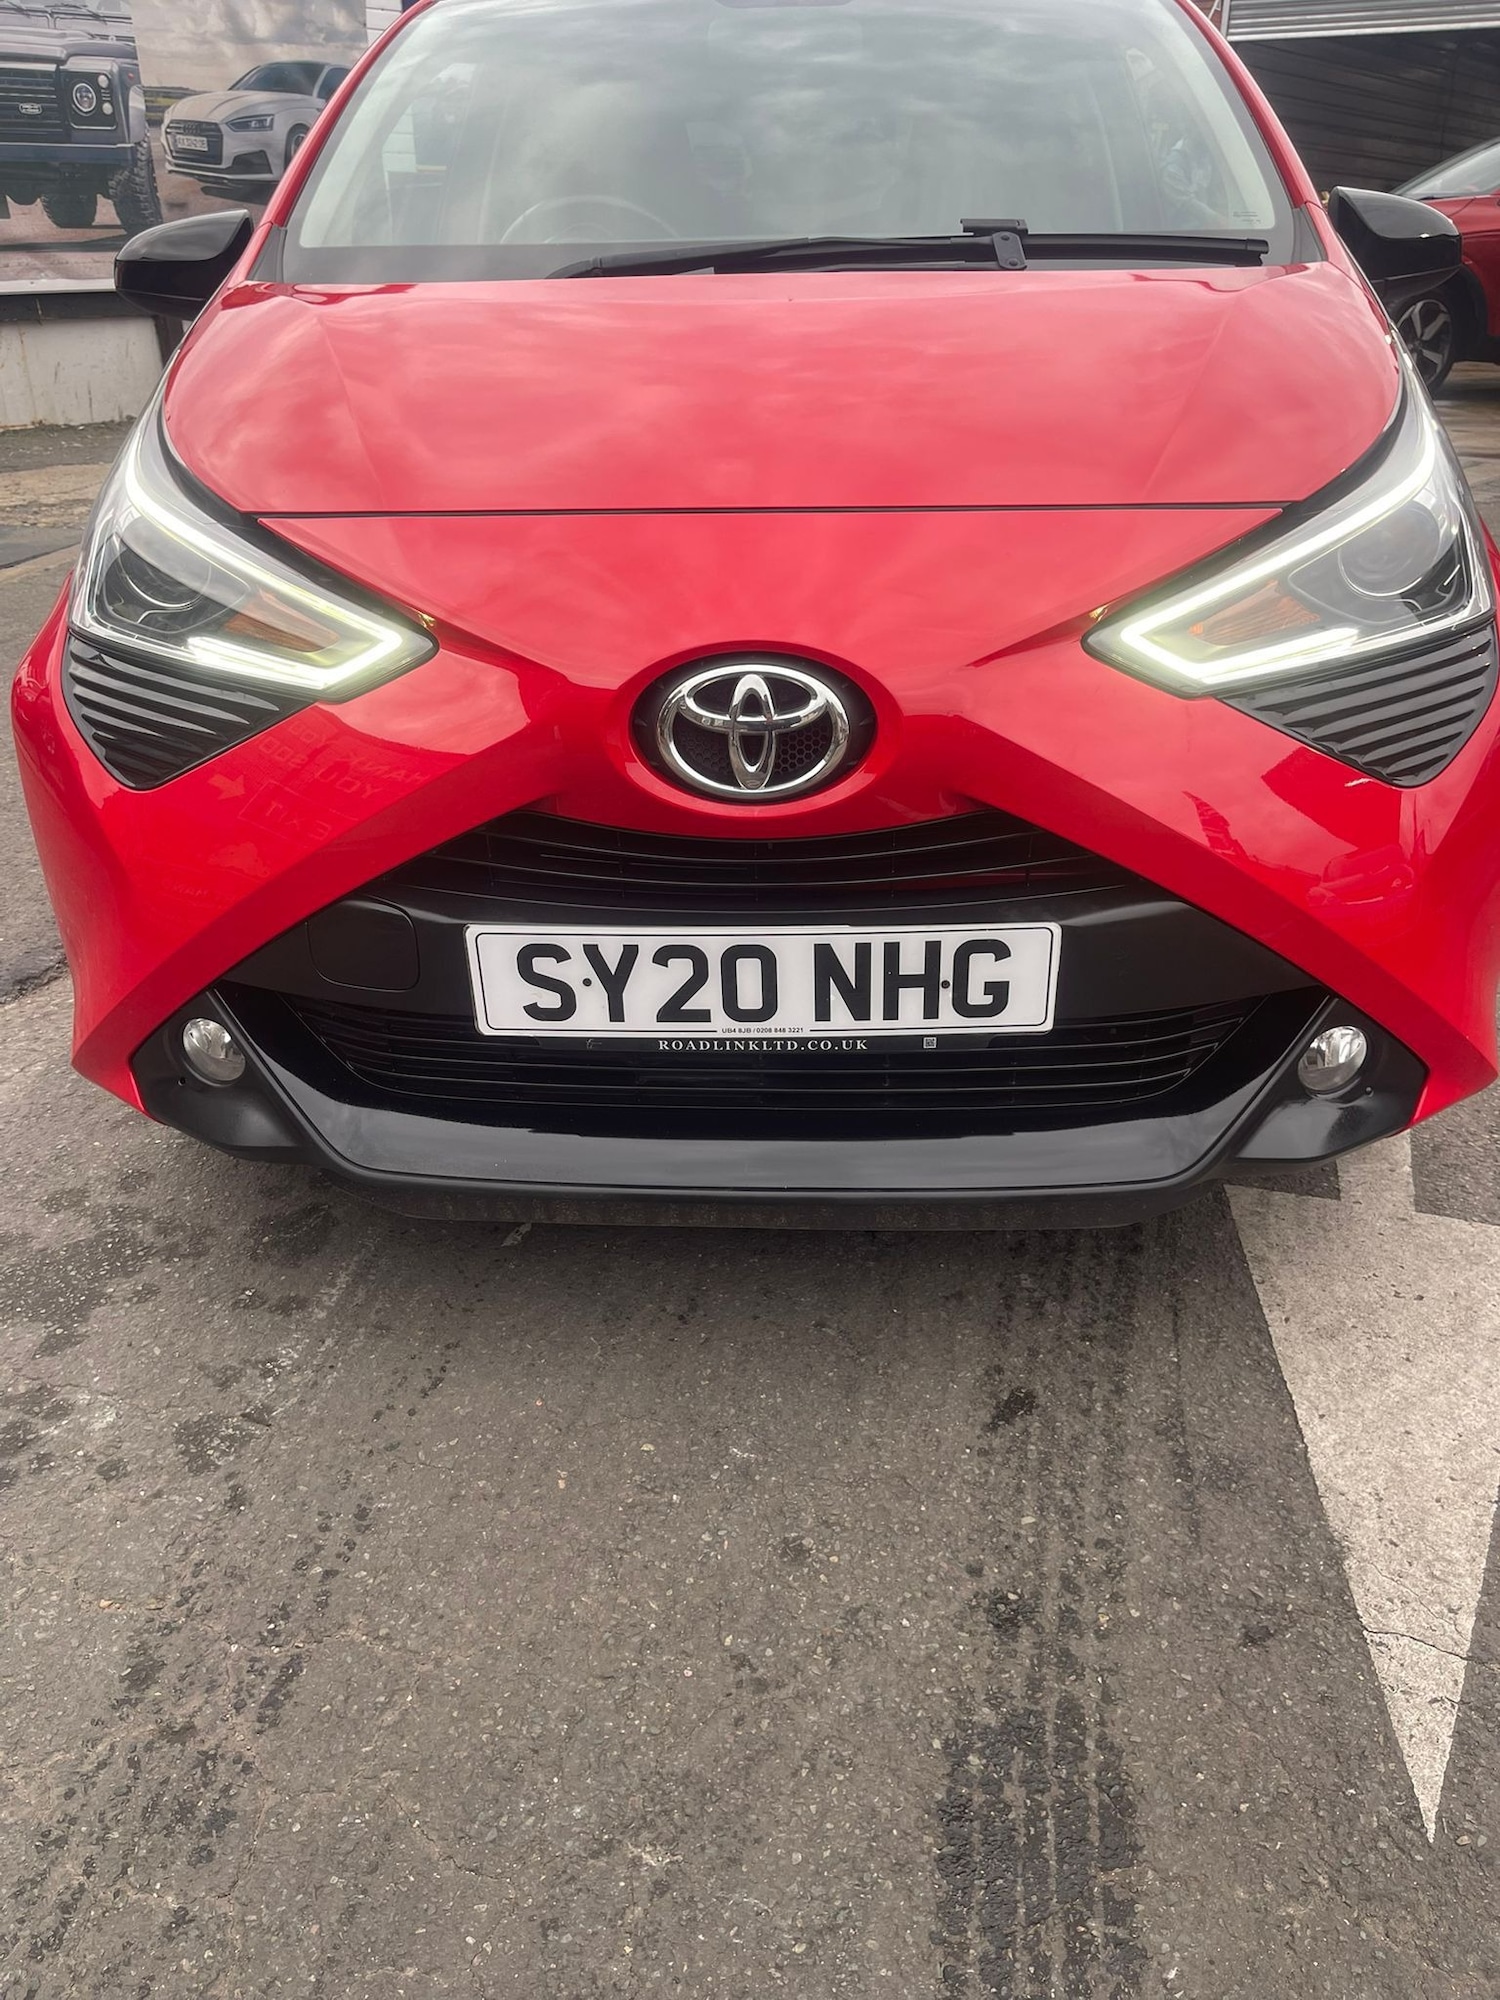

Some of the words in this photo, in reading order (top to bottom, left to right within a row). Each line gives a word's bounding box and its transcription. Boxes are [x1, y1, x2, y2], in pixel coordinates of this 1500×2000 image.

[516, 942, 778, 1023] SY20
[813, 938, 1012, 1022] NHG
[658, 1038, 869, 1052] ROADLINKLTD.CO.UK
